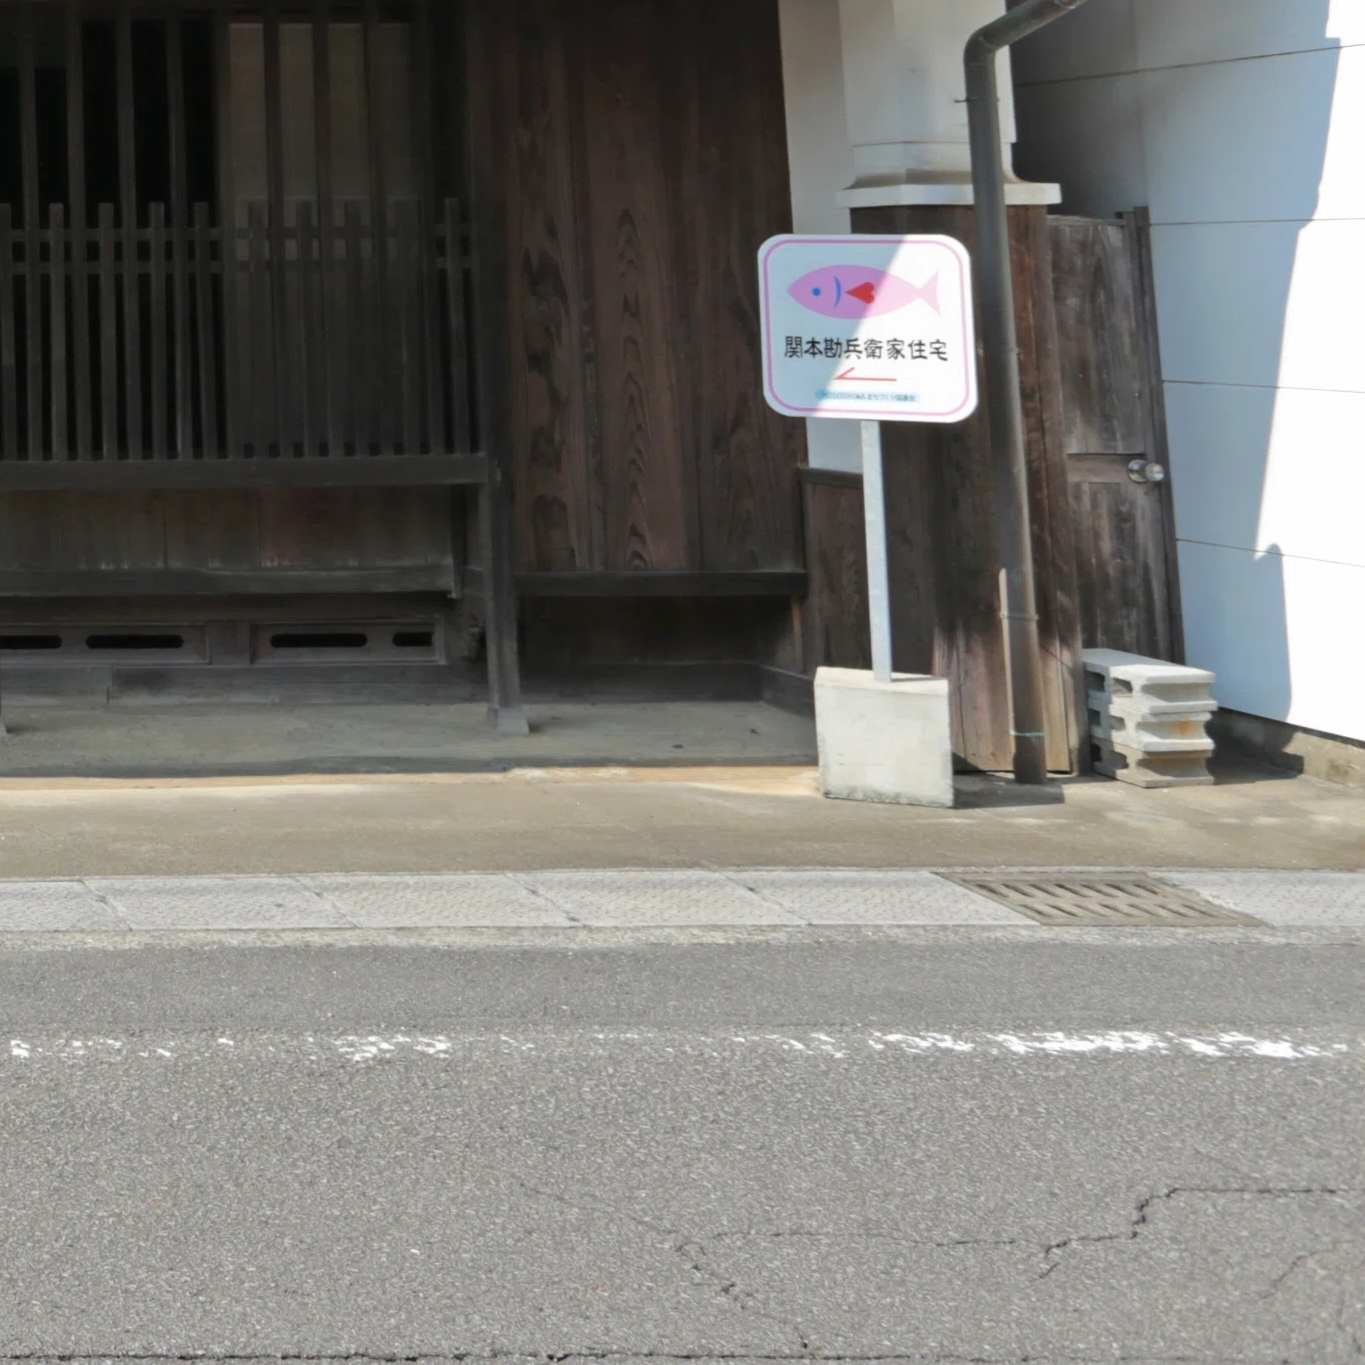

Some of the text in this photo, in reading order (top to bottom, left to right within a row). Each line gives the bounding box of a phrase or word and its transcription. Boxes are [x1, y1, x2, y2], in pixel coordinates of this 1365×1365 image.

[784, 335, 948, 361] 関本勘兵衛家住宅
